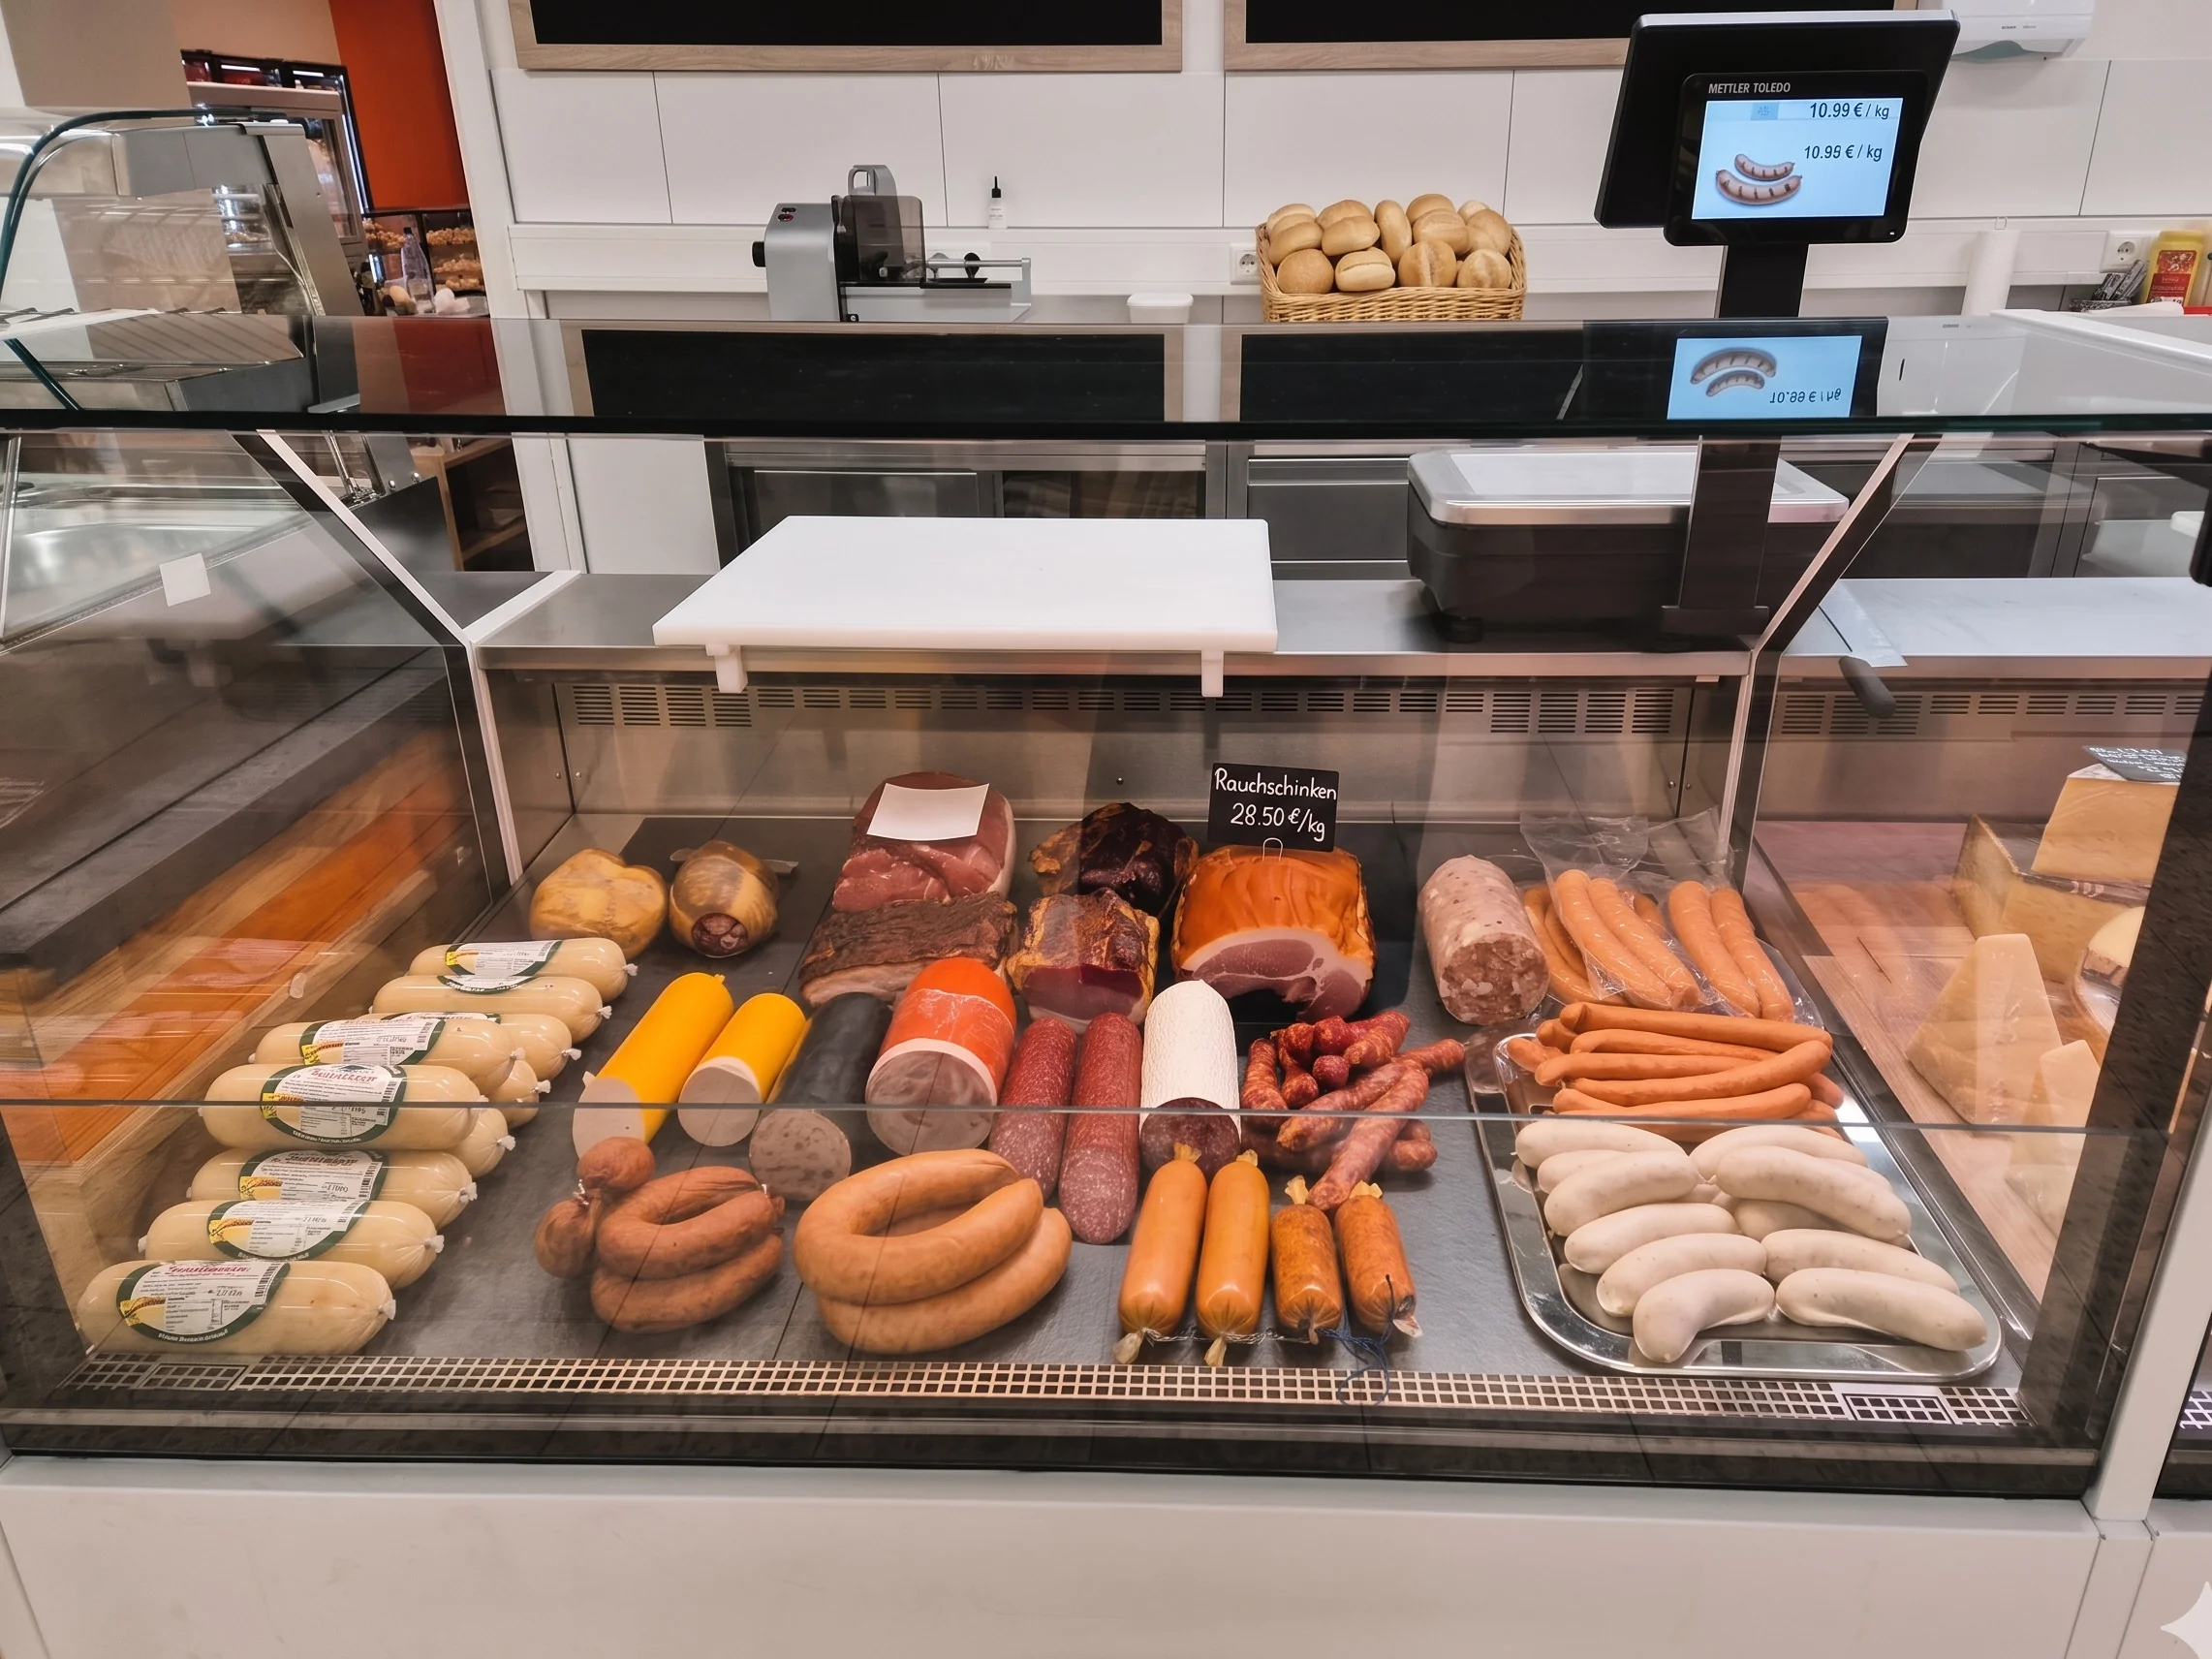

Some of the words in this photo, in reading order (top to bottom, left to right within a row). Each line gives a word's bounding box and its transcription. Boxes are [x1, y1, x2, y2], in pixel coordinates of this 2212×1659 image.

[1708, 83, 1750, 94] METTLER
[1753, 82, 1791, 93] TOLEDO
[1810, 102, 1851, 118] 10.99
[1214, 767, 1337, 800] Rauchschinken
[1230, 802, 1285, 827] 28.50
